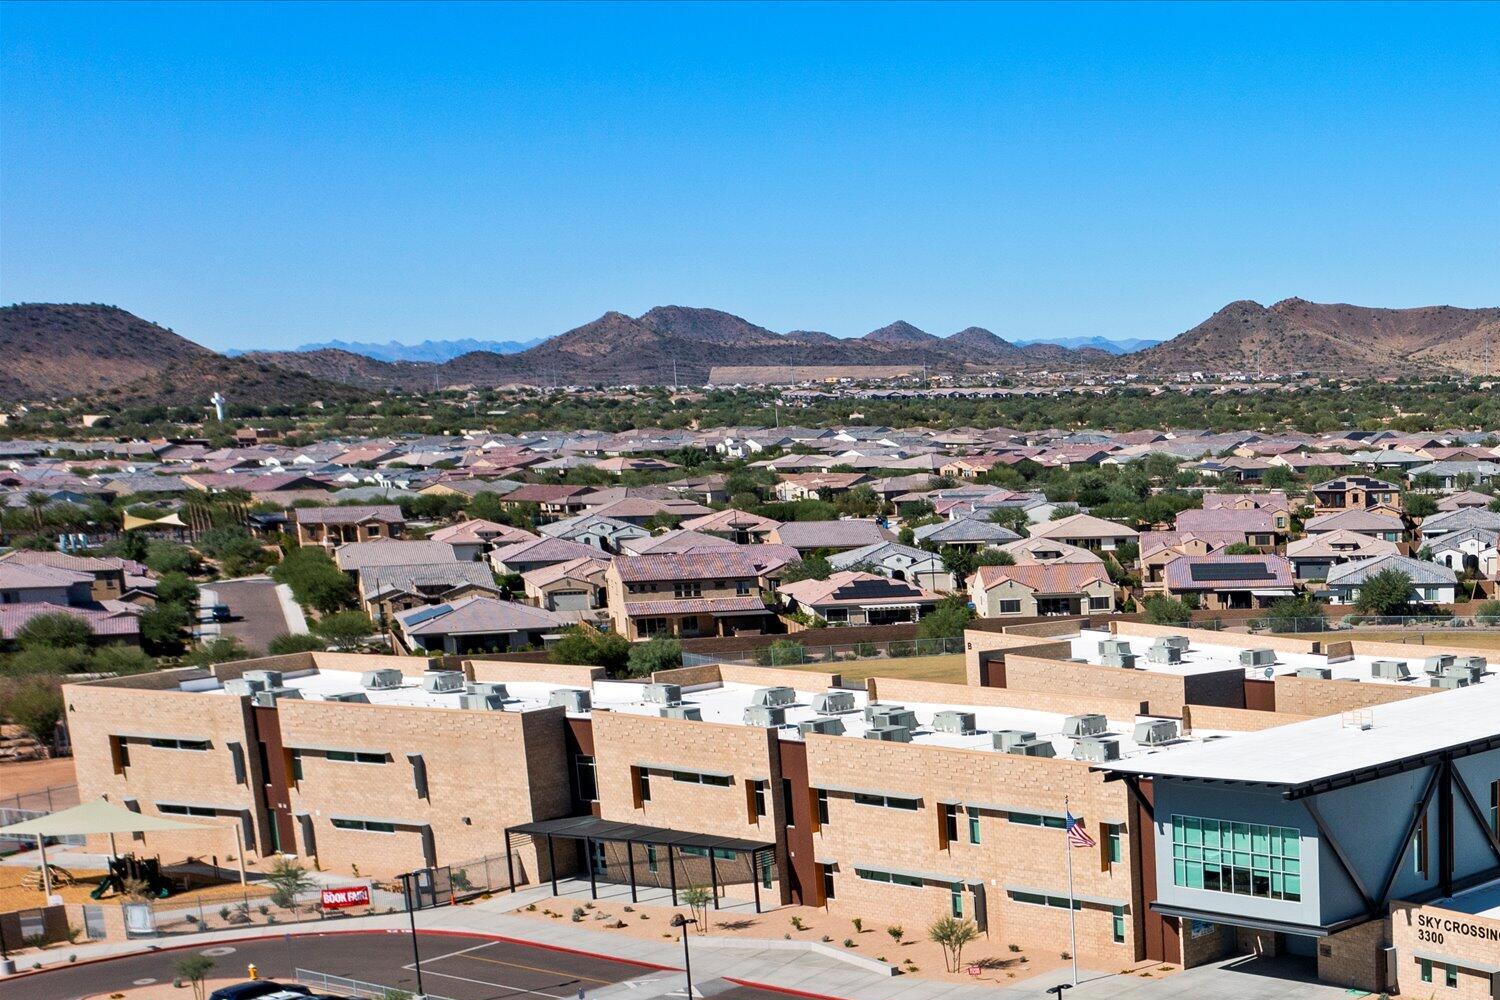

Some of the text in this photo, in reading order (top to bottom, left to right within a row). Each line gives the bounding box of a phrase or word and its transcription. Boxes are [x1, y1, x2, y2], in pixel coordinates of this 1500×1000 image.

[69, 703, 76, 712] A
[323, 891, 347, 903] BOOK
[1418, 914, 1441, 930] SKY
[1418, 928, 1444, 945] 3300
